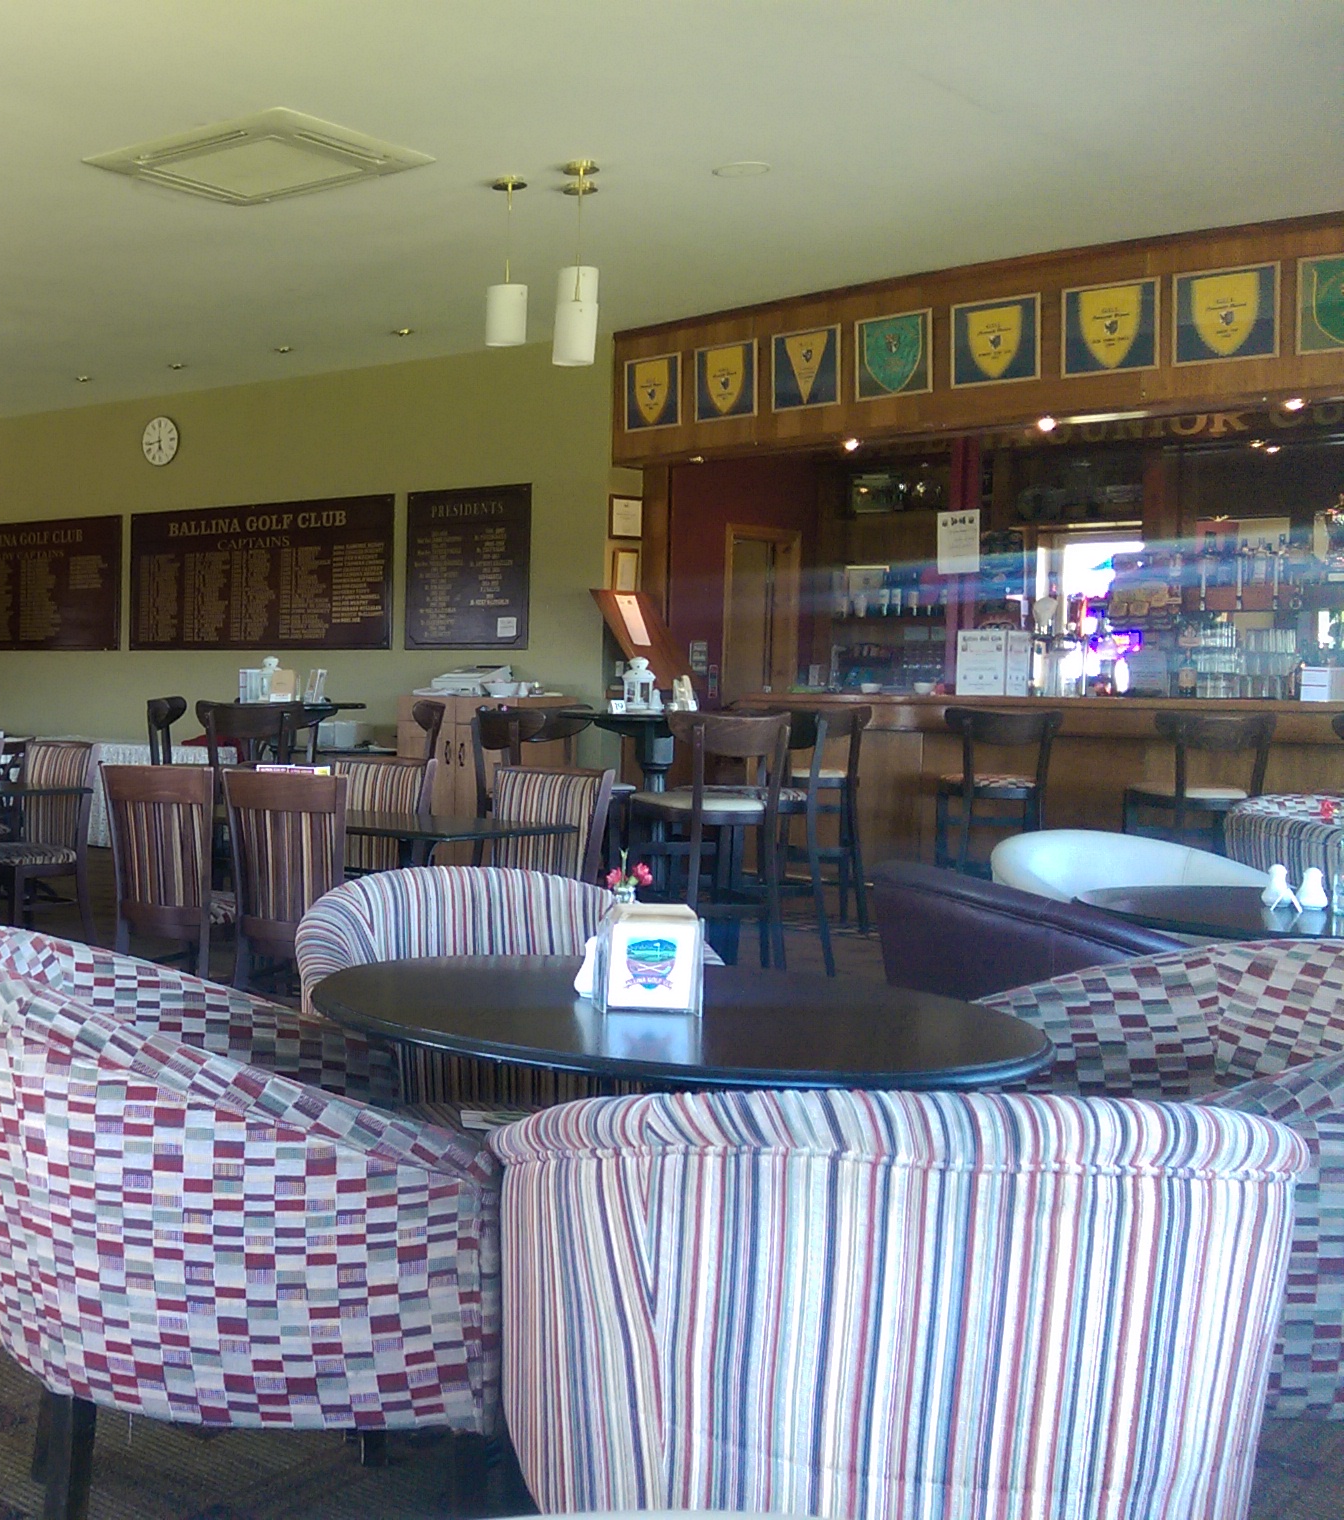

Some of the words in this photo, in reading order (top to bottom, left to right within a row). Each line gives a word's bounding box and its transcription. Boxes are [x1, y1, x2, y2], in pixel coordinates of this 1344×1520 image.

[431, 501, 504, 518] PRESIDENTS
[168, 517, 241, 537] BALLINA
[245, 513, 294, 532] GOLF
[297, 510, 347, 529] CLUB
[19, 531, 50, 546] GOLF
[52, 528, 83, 543] CLUB
[217, 535, 290, 550] CAPTAINS
[16, 549, 65, 561] CAPTAINS
